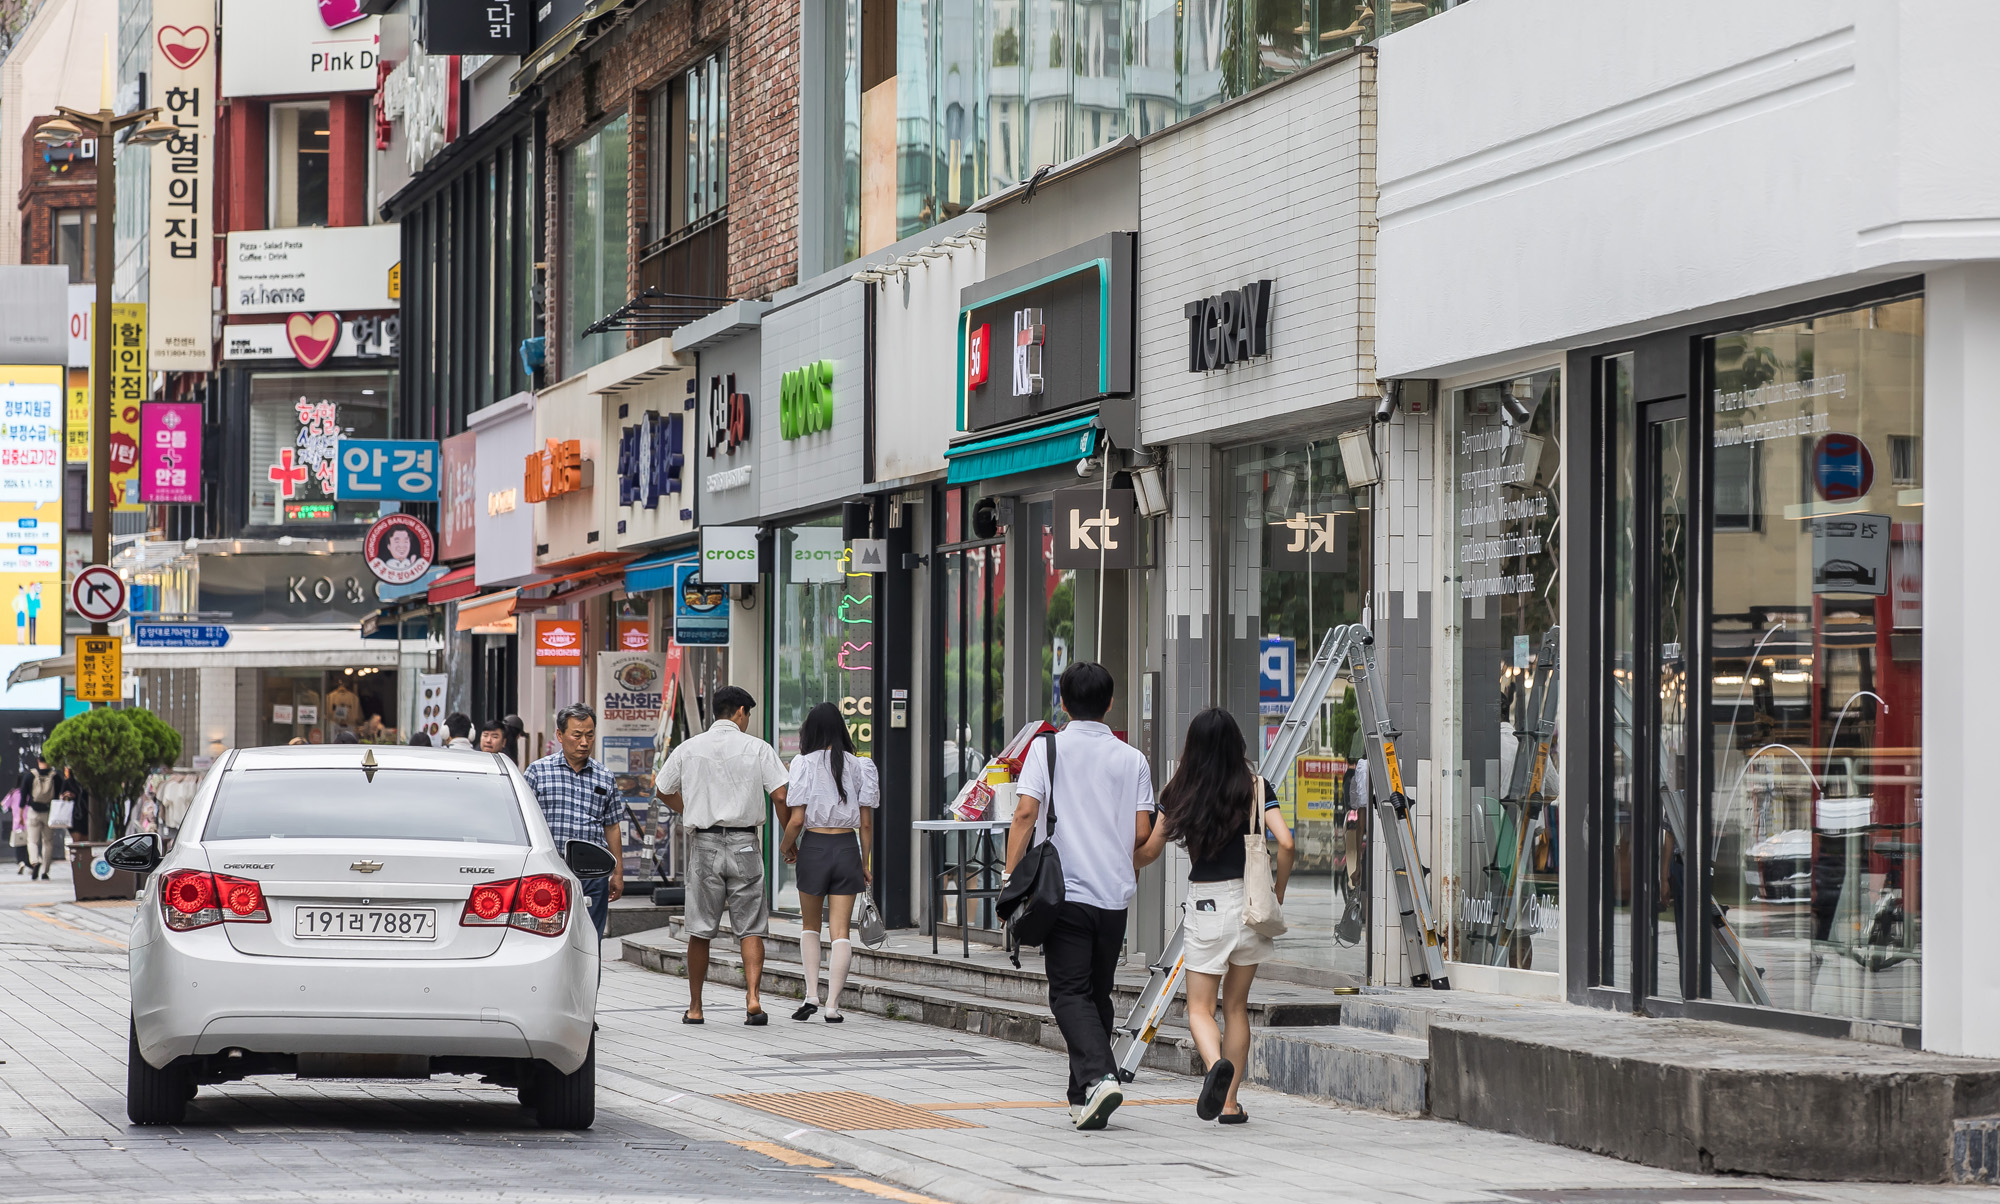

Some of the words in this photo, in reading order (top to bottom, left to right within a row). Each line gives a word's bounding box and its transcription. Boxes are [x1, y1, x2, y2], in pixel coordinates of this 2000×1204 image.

[485, 0, 515, 38] 닭
[120, 323, 143, 399] 할인점
[970, 336, 981, 377] 5G
[780, 360, 833, 441] crocs
[10, 425, 46, 441] 부정수급
[343, 447, 433, 493] 안경
[1069, 508, 1120, 550] kt
[706, 549, 756, 560] crocs
[288, 575, 335, 604] KO
[459, 867, 496, 875] CRUZE
